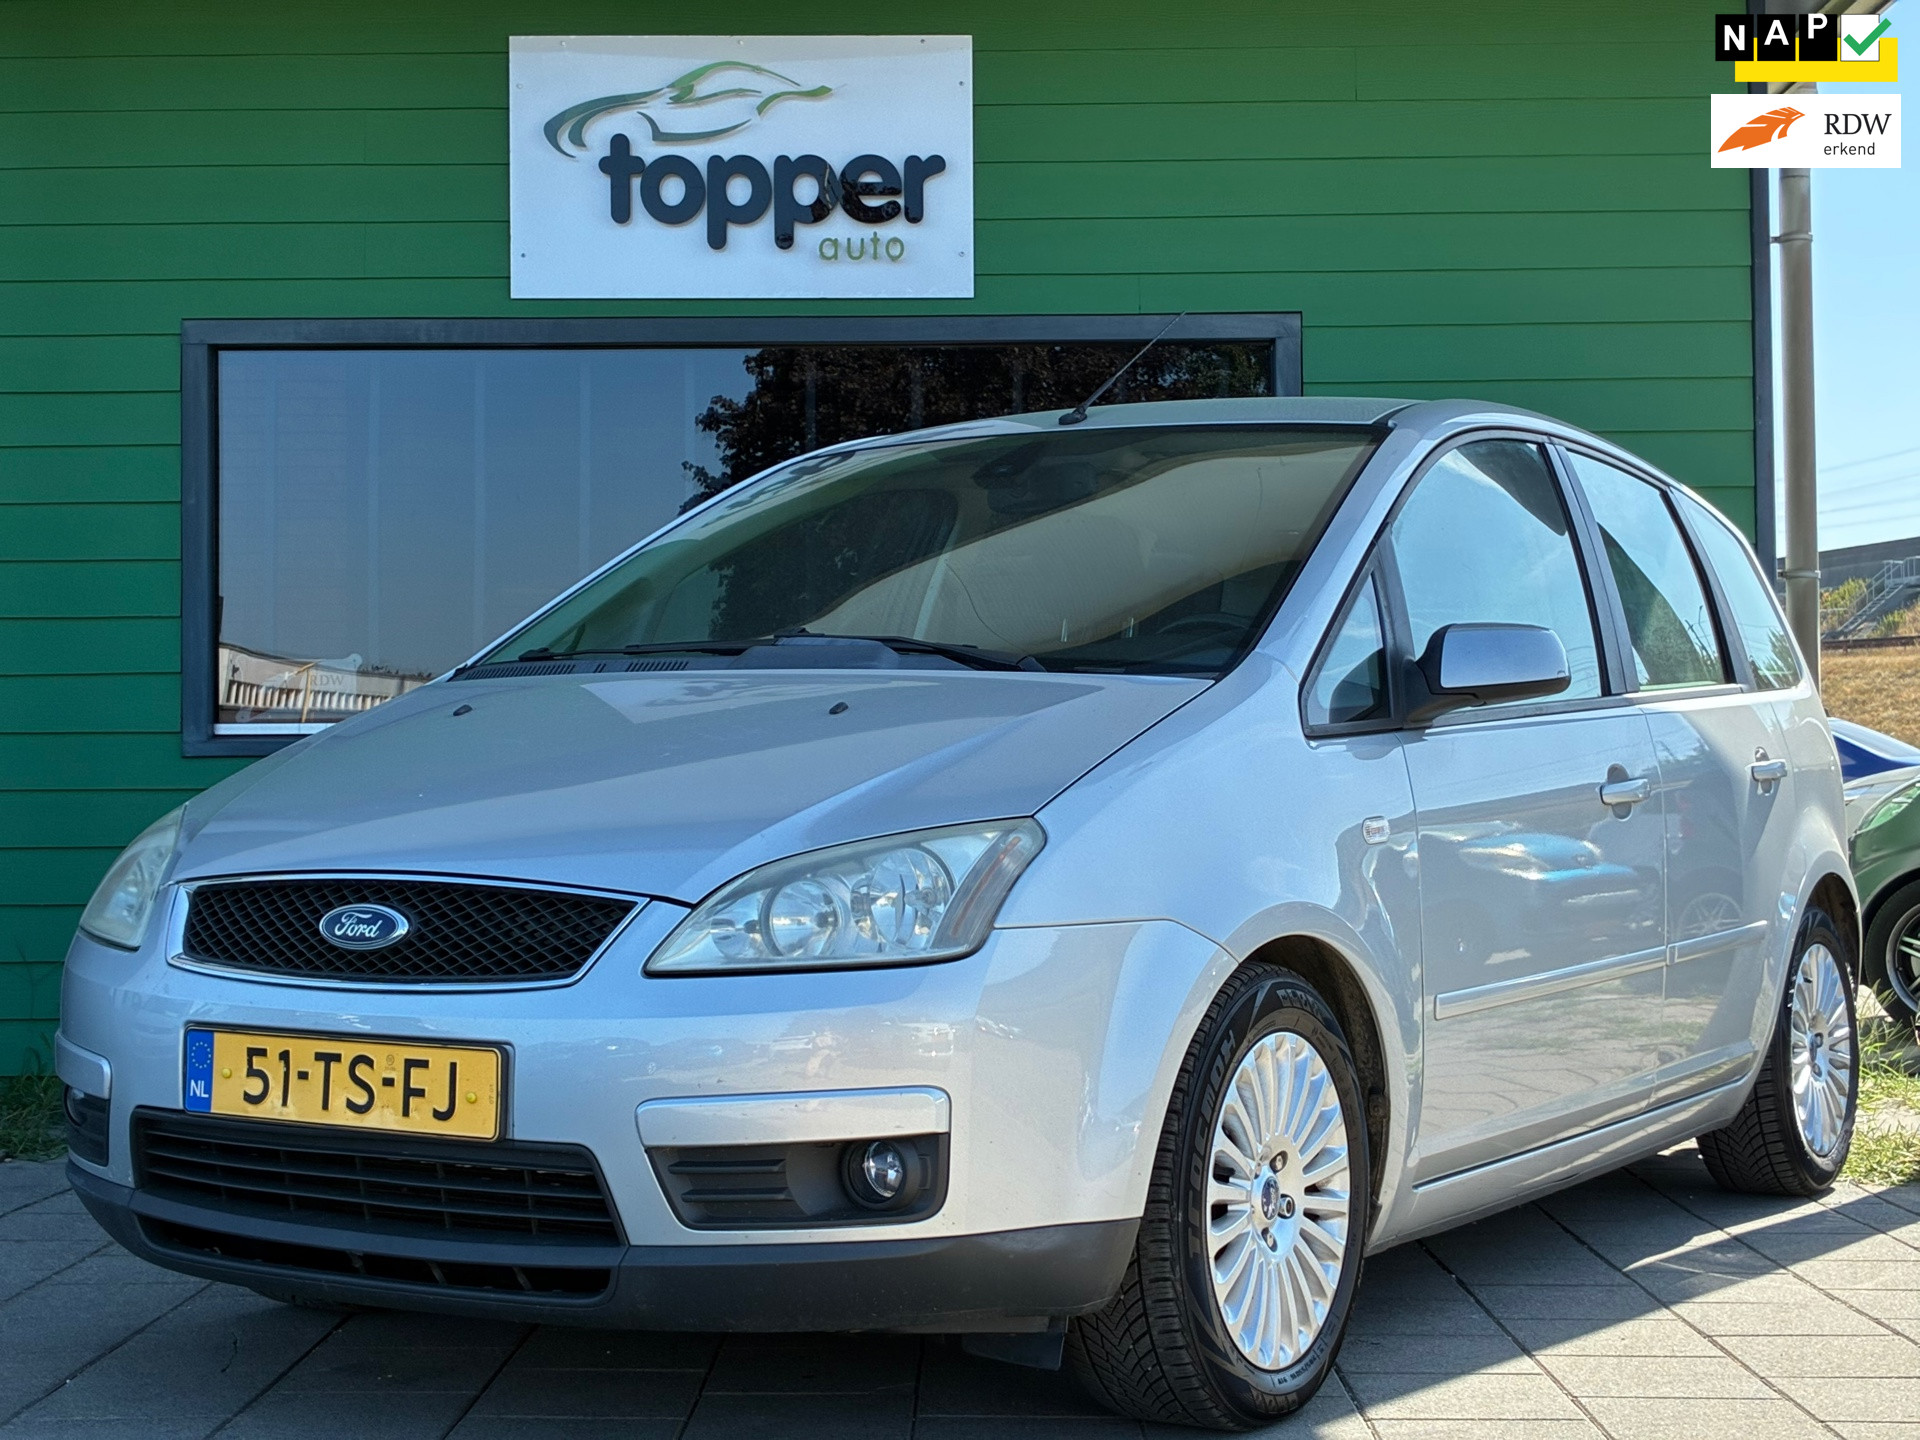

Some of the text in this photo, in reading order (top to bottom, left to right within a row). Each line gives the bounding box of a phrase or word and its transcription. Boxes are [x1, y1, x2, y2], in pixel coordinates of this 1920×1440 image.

[598, 133, 946, 250] topper
[818, 231, 905, 261] auto
[334, 911, 383, 938] Ford
[190, 1080, 209, 1098] NL
[243, 1046, 458, 1121] 51-TS-FJ
